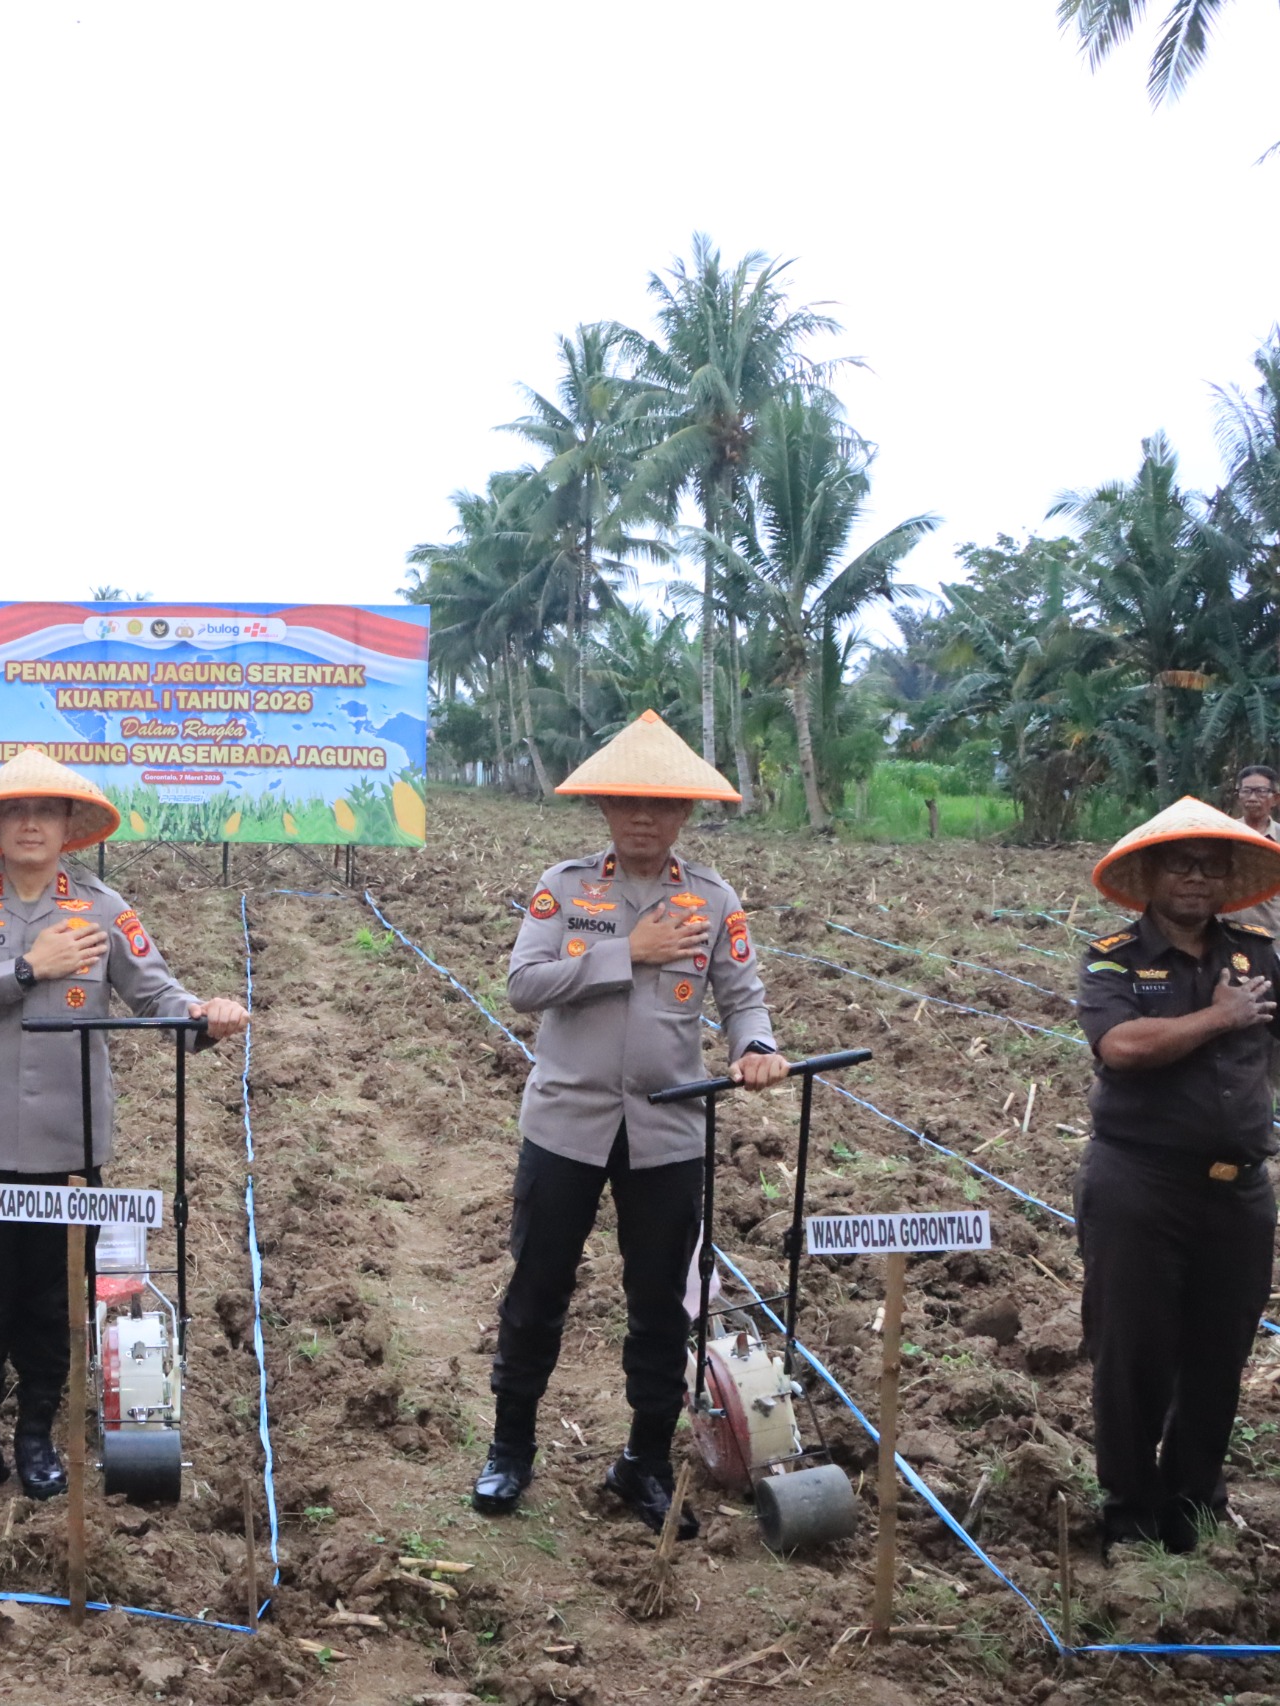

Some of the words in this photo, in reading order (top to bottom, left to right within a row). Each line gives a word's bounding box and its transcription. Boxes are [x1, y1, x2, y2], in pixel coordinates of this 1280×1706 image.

[207, 623, 240, 637] bulog
[6, 662, 149, 682] PENANAMAN
[153, 663, 243, 683] JAGUNG
[247, 665, 365, 685] SERENTAK
[57, 689, 158, 709] KUARTAL
[162, 691, 171, 710] I
[176, 691, 250, 711] TAHUN
[254, 691, 313, 711] 2026
[122, 718, 178, 737] Dalam
[182, 718, 246, 741] Rangka
[131, 744, 291, 766] SWASEMBADA
[295, 747, 385, 767] JAGUNG
[144, 773, 178, 781] Gorontalo,
[160, 794, 205, 802] PRESISI
[567, 917, 616, 934] SIMSON
[67, 1192, 156, 1224] GORONTALO
[812, 1218, 897, 1249] WAKAPOLDA
[900, 1215, 983, 1247] GORONTALO
